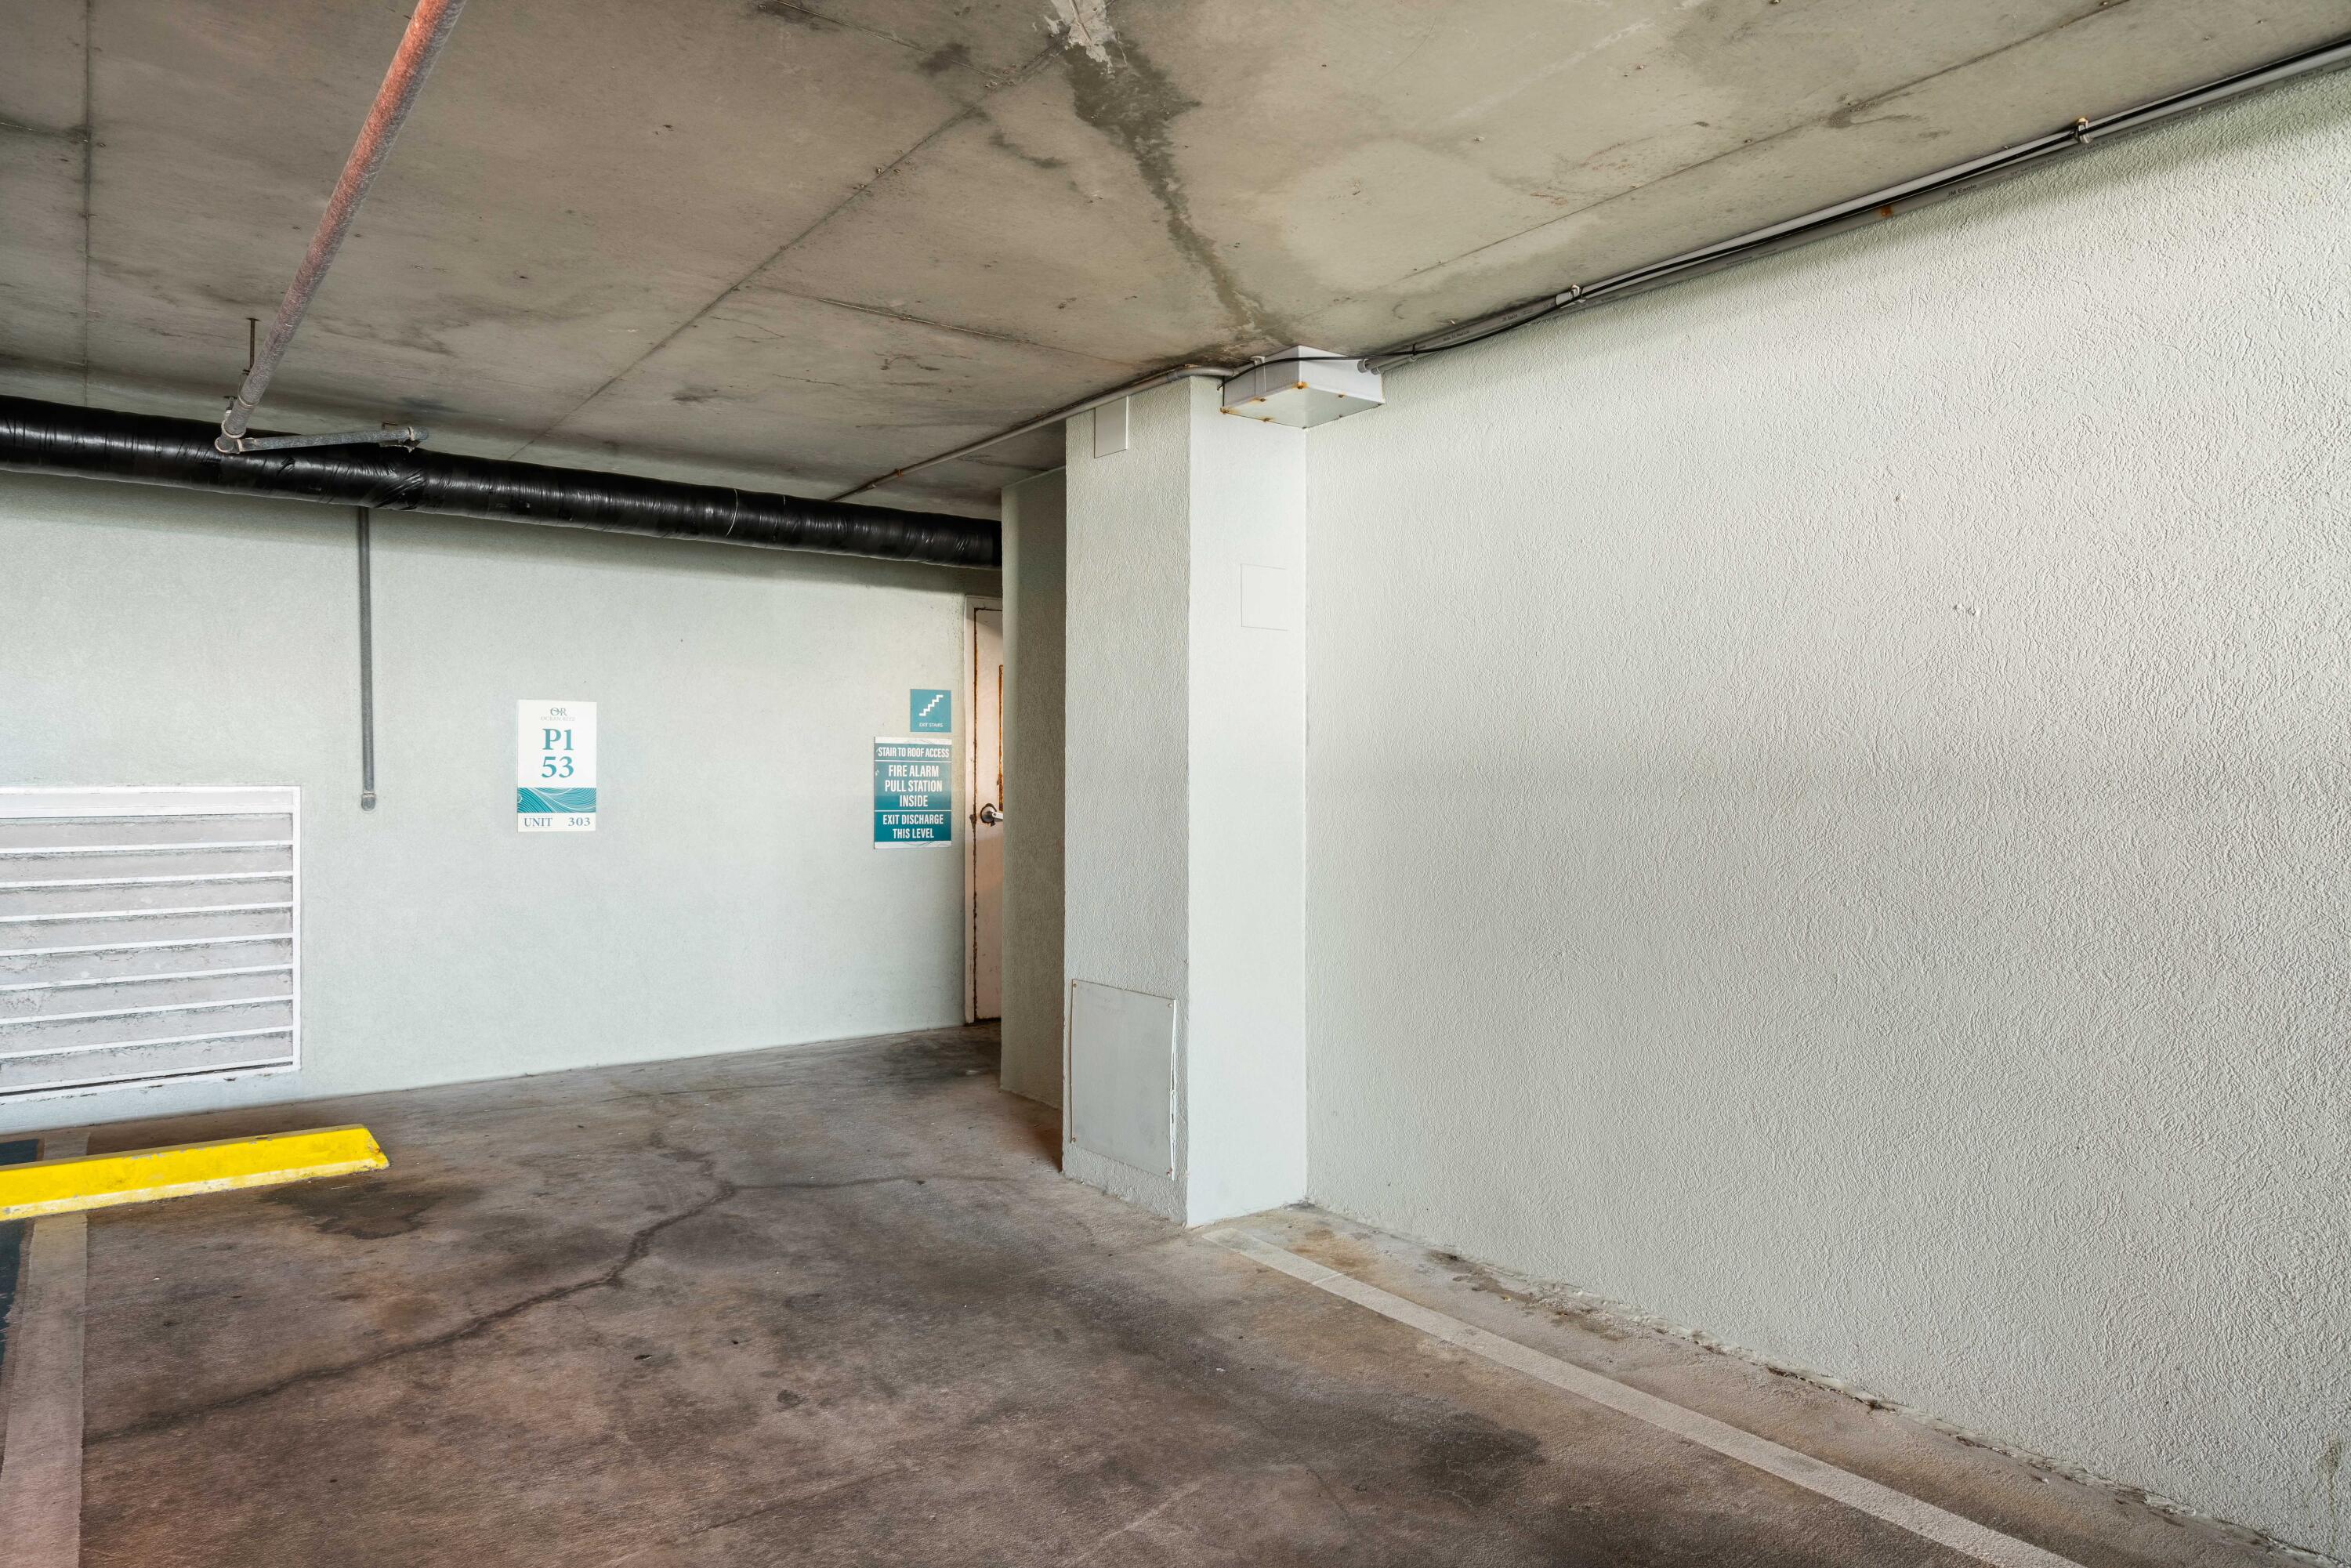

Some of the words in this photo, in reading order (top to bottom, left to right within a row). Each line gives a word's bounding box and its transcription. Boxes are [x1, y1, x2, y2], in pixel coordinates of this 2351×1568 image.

[542, 729, 574, 751] P1
[878, 748, 898, 757] STAIR
[898, 748, 906, 757] TO
[907, 748, 925, 757] ROOF
[925, 748, 950, 759] ACCESS
[541, 756, 574, 778] 53
[889, 765, 907, 777] FIRE
[909, 765, 939, 777] ALARM
[885, 780, 907, 791] PULL
[908, 780, 942, 792] STATION
[900, 795, 928, 807] INSIDE
[523, 817, 552, 827] UNIT
[567, 817, 590, 827] 303
[882, 815, 899, 824] EXIT
[901, 814, 944, 824] DISCHARGE
[893, 828, 910, 838] THIS
[912, 827, 934, 838] LEVEL
